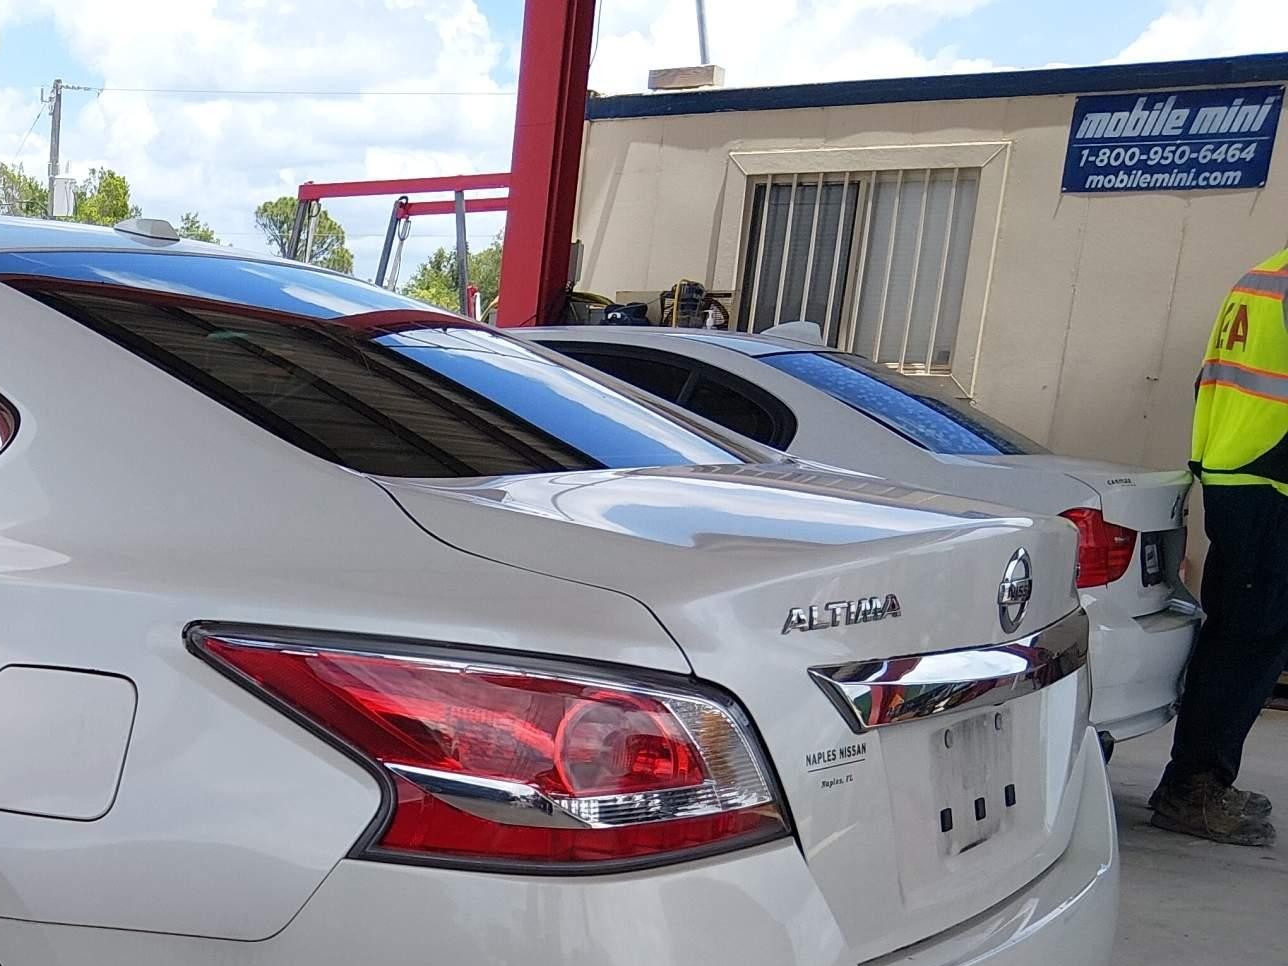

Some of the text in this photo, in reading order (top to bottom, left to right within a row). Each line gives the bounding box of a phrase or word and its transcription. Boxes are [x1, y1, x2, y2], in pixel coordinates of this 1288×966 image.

[1075, 96, 1273, 138] mobile mini
[1079, 142, 1257, 167] 1-800-950-6464
[1085, 168, 1242, 189] mobilemini.com
[780, 593, 902, 635] ALTIMA
[805, 742, 867, 767] NAPLES NISSAN
